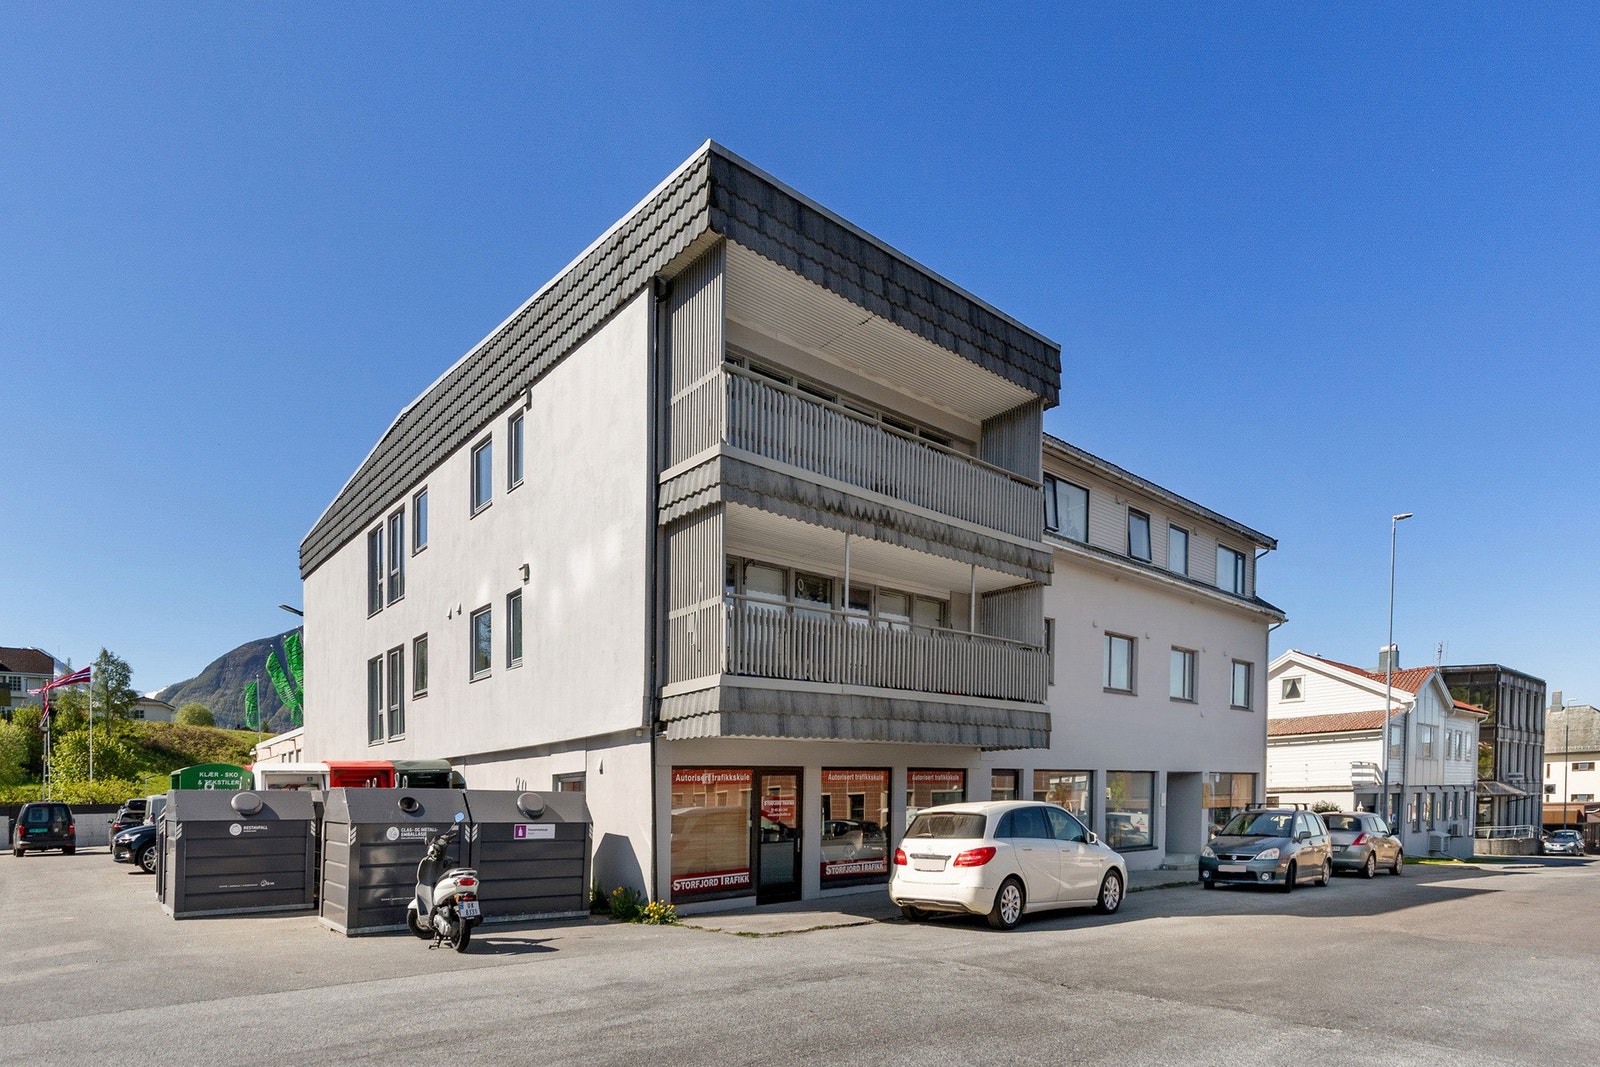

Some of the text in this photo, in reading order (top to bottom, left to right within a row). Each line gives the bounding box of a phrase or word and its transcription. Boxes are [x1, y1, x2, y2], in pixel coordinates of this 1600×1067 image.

[675, 774, 711, 782] Autorisert
[826, 861, 884, 875] STORFJORD TRAFIKK
[673, 872, 750, 891] STORFJORD TRAFIKK
